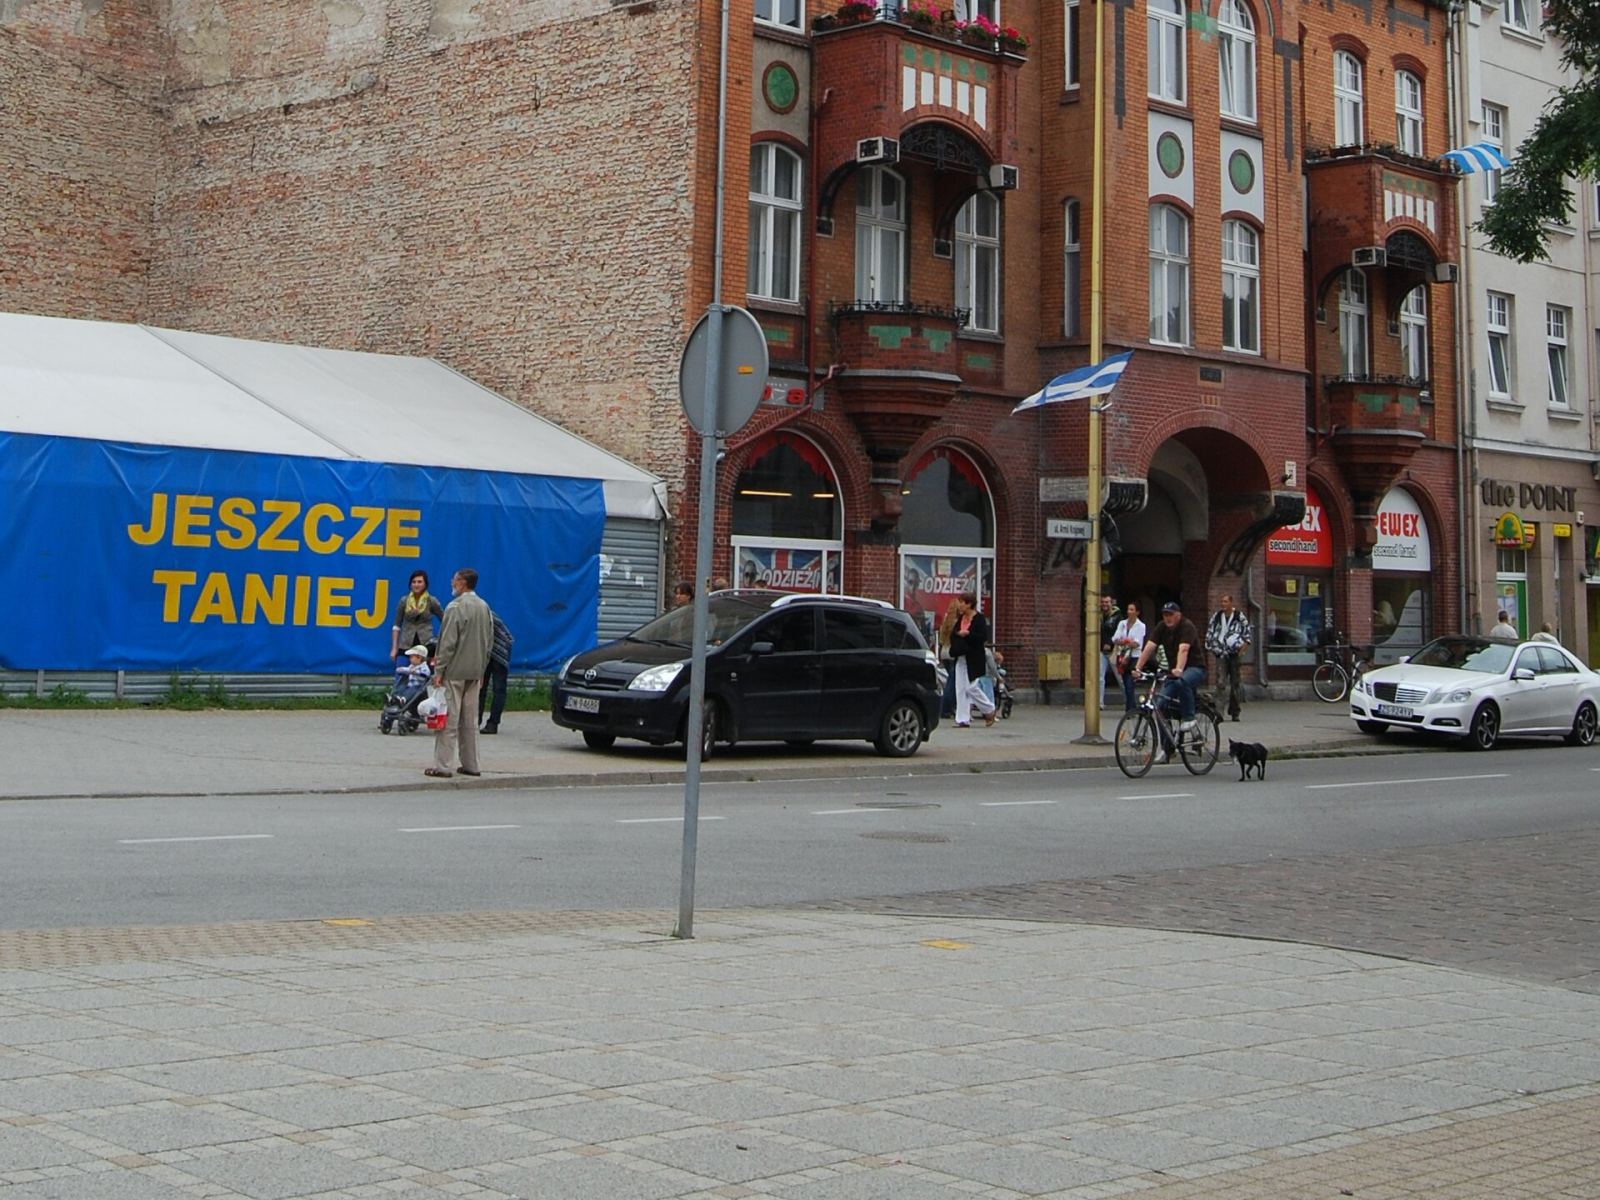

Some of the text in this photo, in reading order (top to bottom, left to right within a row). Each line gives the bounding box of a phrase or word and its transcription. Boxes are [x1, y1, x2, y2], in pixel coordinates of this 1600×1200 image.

[1481, 478, 1577, 513] the POINT
[127, 492, 421, 558] JESZCZE
[1269, 538, 1317, 554] second hand
[1373, 544, 1417, 559] second hand
[152, 570, 389, 629] TANIEJ
